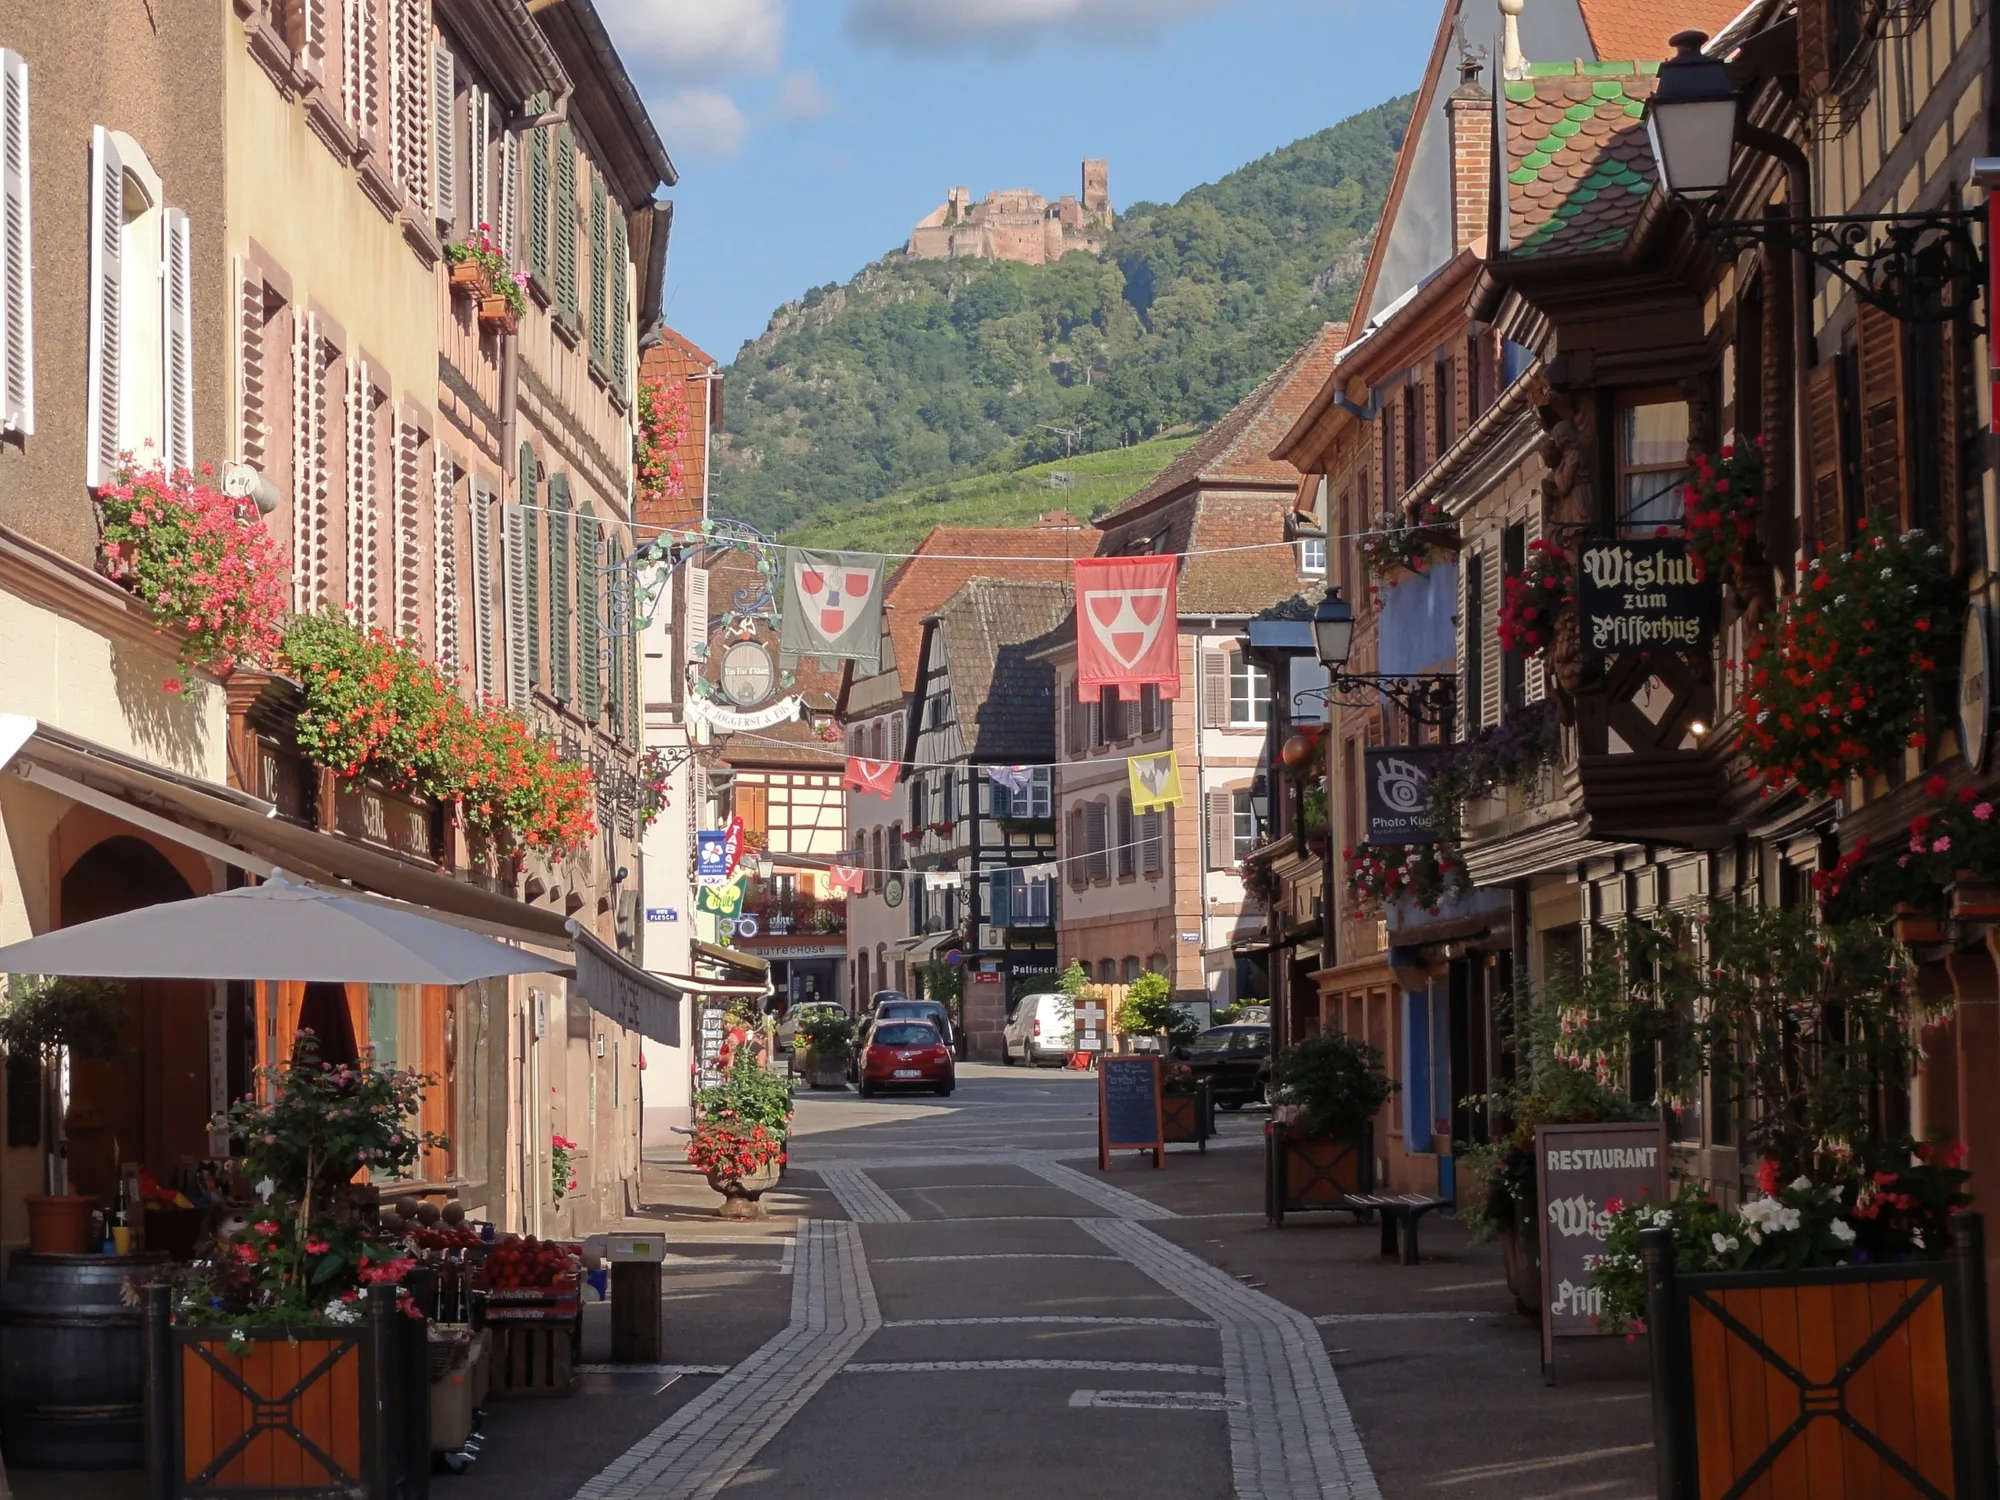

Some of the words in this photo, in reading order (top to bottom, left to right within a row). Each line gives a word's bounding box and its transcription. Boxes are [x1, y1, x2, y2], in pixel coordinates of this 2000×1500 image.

[1623, 593, 1668, 609] zum
[1591, 614, 1700, 648] Pfifferhüs
[1372, 816, 1407, 828] Photo
[1548, 1148, 1658, 1170] RESTAURANT
